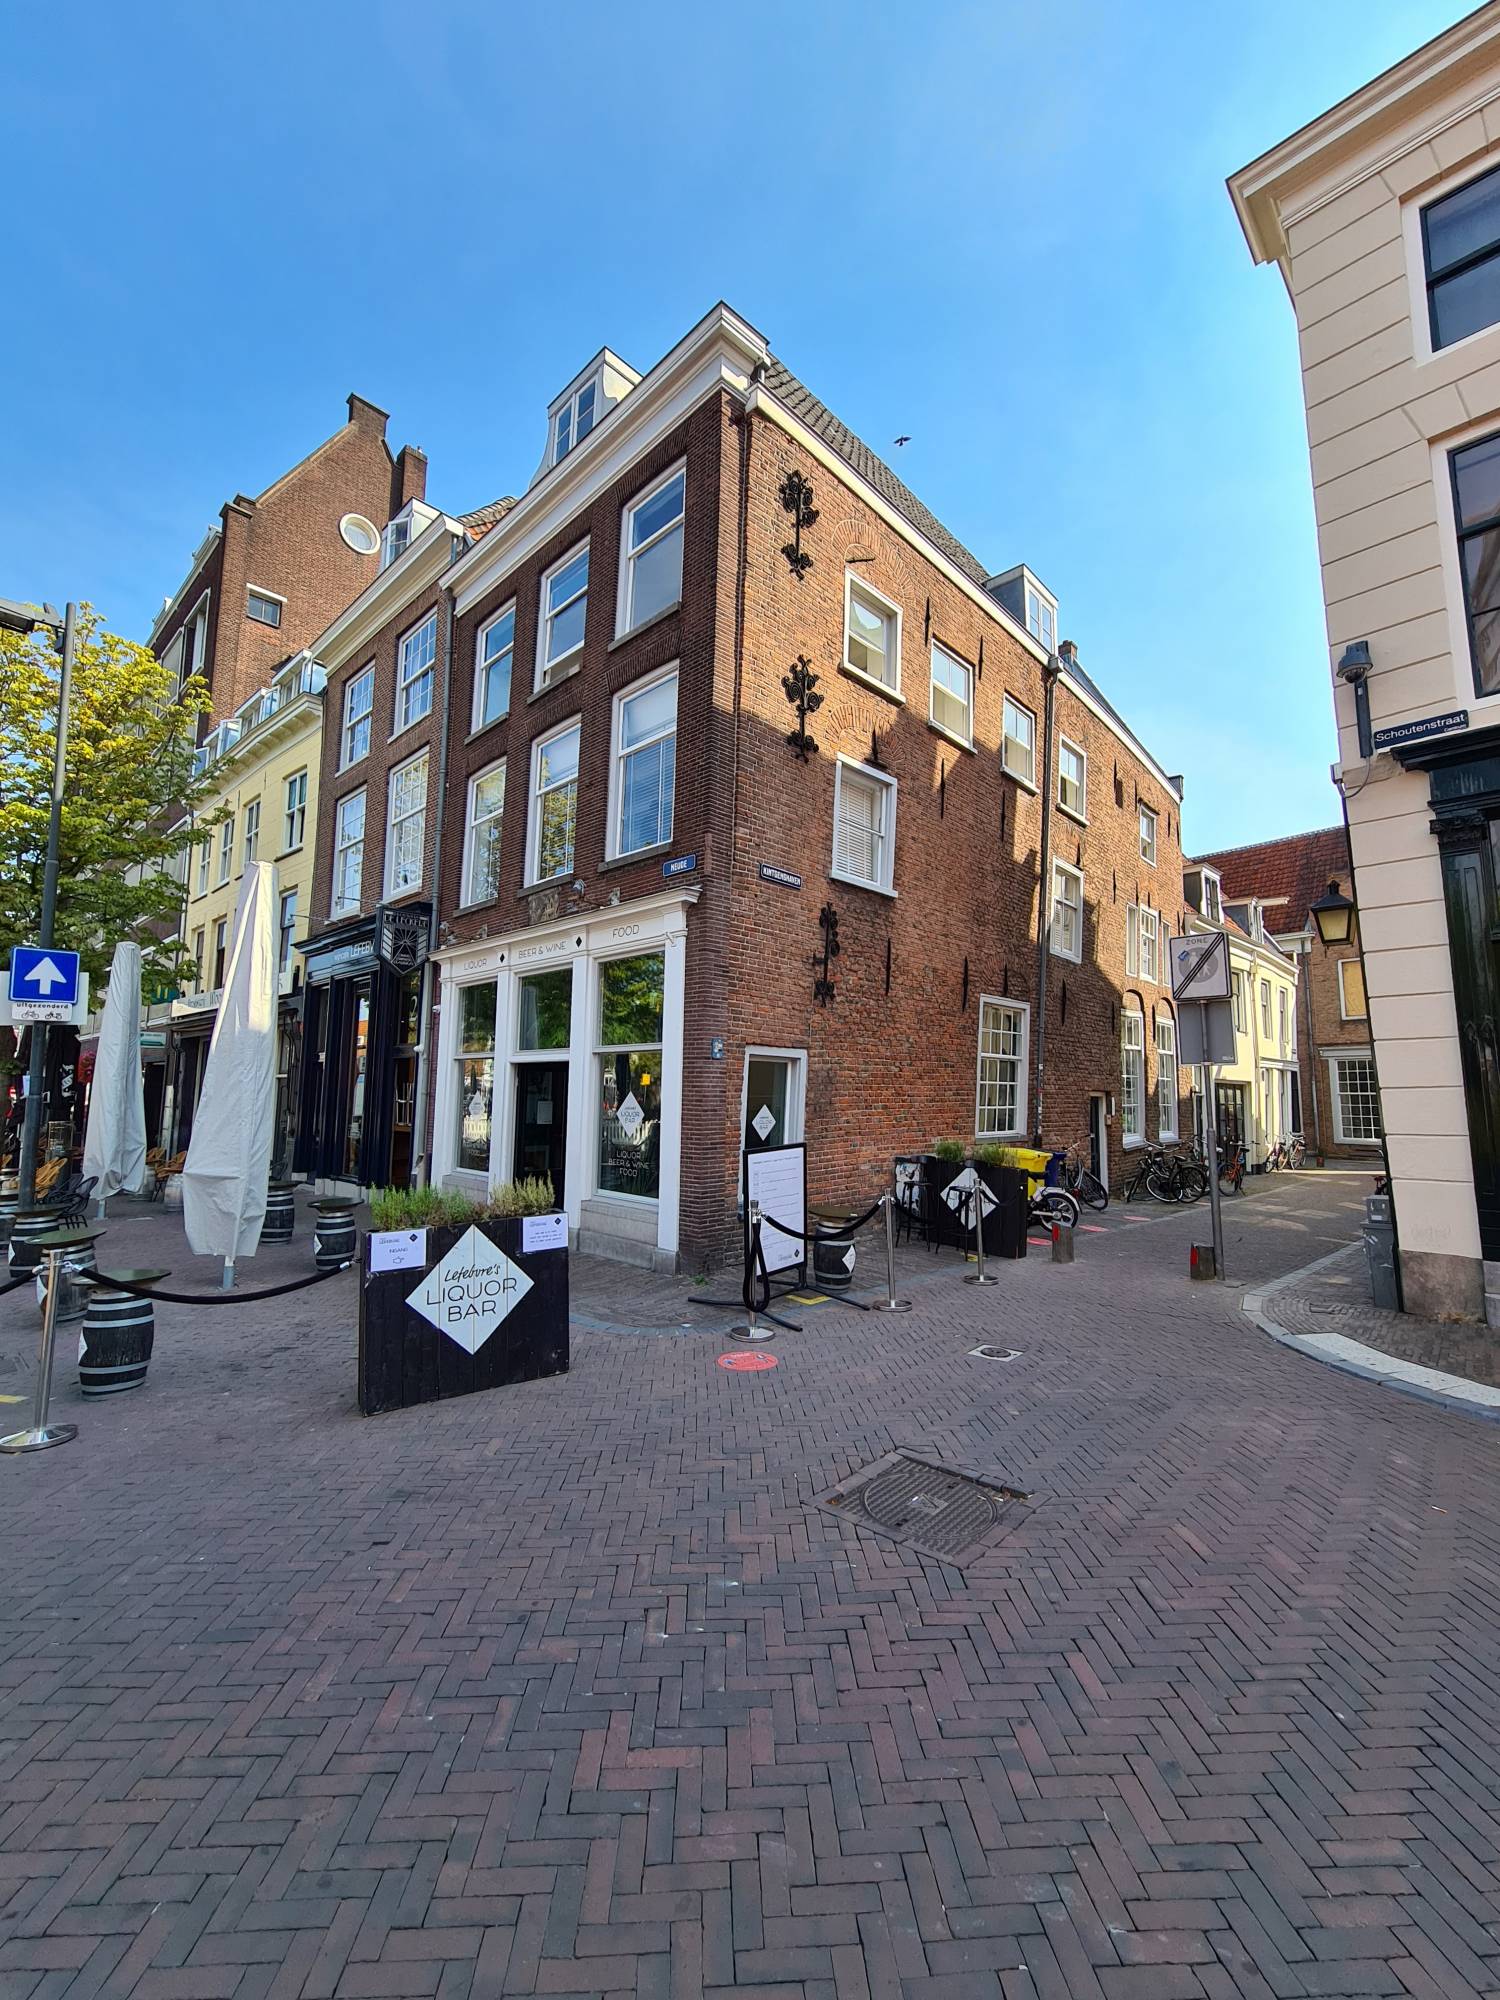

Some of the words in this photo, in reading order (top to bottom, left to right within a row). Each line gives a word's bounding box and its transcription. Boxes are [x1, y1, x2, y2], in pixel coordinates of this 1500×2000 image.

[1375, 713, 1465, 742] Schoutenstraat
[670, 859, 688, 872] NEUDE
[612, 924, 640, 939] FOOD
[1185, 937, 1208, 945] ZONE
[518, 947, 537, 960] BEER
[538, 947, 544, 955] &
[545, 940, 567, 953] WINE
[463, 957, 487, 971] LIQUOR
[616, 1151, 641, 1160] LIQUOR
[608, 1158, 625, 1167] BEER
[631, 1161, 650, 1170] WINE
[619, 1168, 638, 1177] FOOD
[444, 1263, 501, 1283] Lefebvre's
[426, 1277, 518, 1306] LIQUOR
[447, 1300, 497, 1323] BAR
